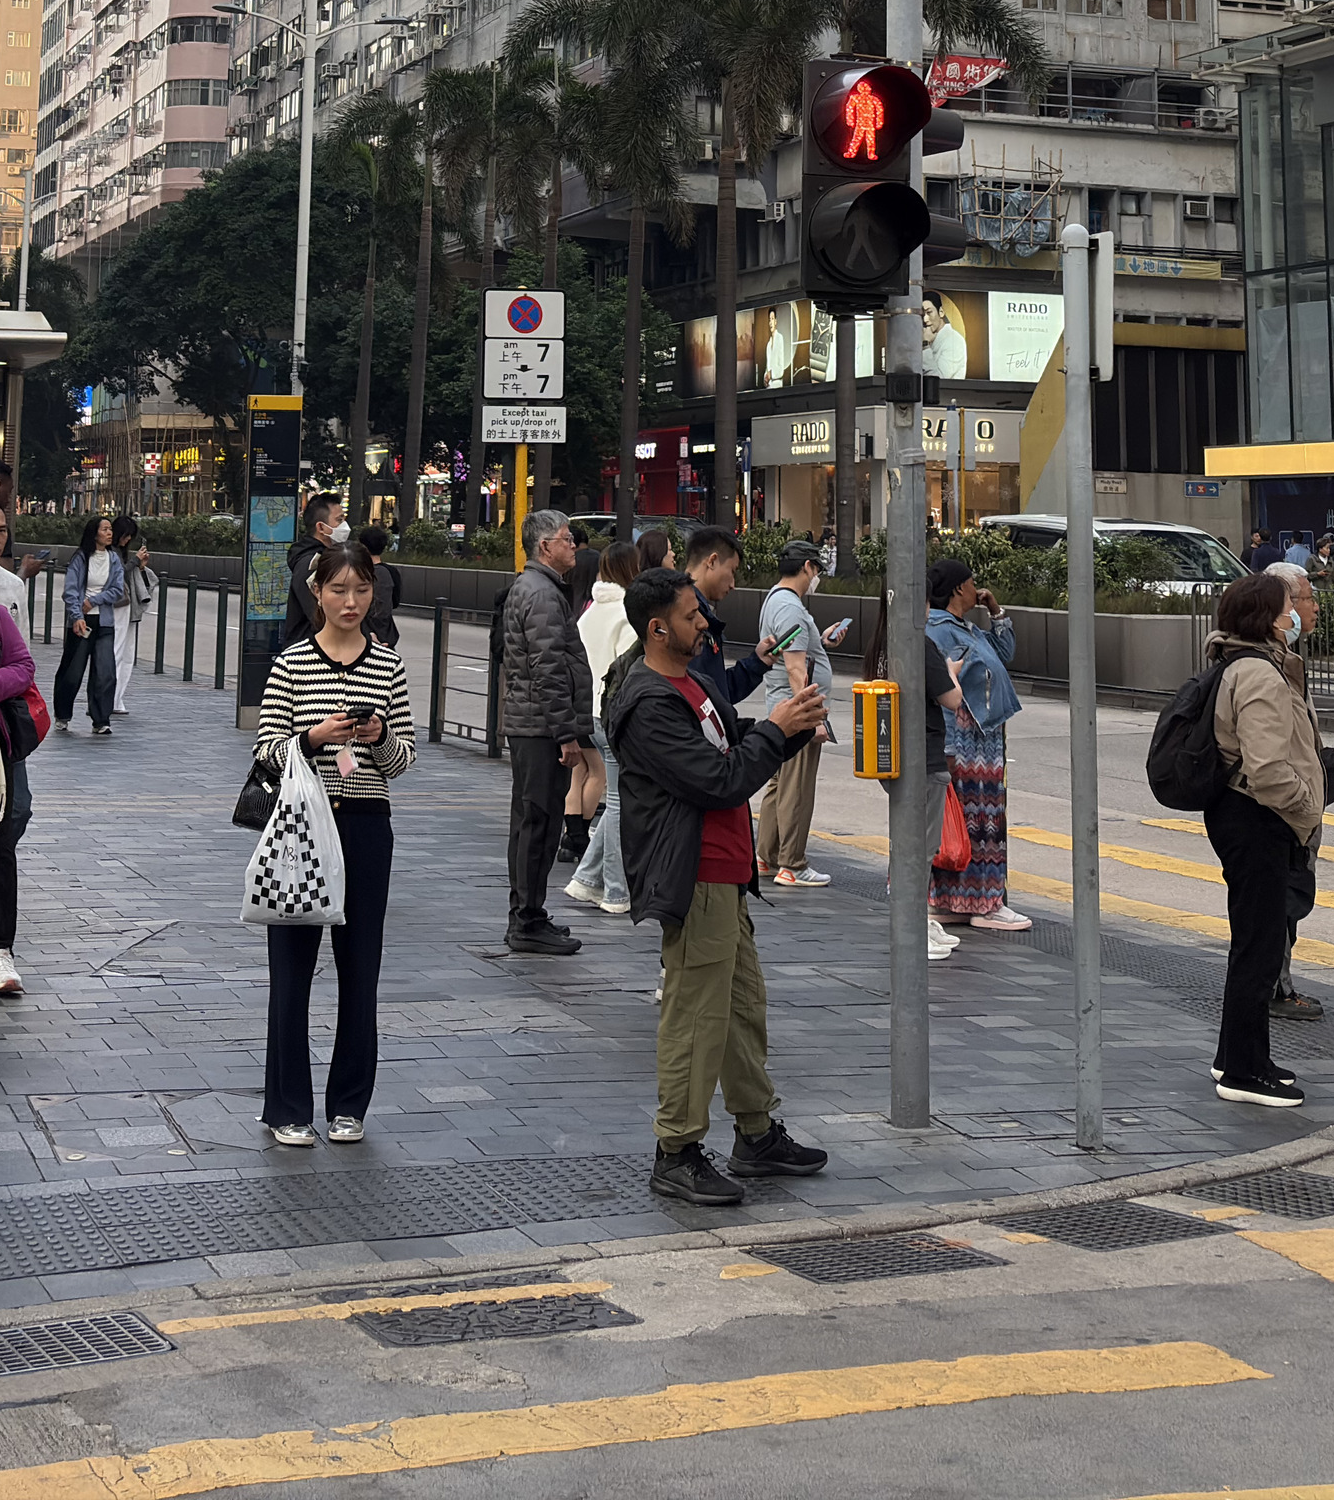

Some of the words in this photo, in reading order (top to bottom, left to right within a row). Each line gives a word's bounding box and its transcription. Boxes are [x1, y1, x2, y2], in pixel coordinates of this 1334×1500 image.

[1007, 302, 1048, 314] RADO
[499, 351, 522, 363] 上午
[537, 343, 550, 362] 7
[1006, 350, 1031, 373] Feel
[498, 383, 522, 394] 下午
[503, 373, 518, 381] pm
[536, 375, 550, 394] 7
[501, 408, 531, 418] Except
[531, 409, 547, 417] taxi
[491, 418, 508, 426] pick
[510, 418, 543, 427] up/drop
[544, 418, 557, 426] off
[922, 418, 995, 440] RAO
[486, 429, 561, 440] 的士上落客除外
[791, 421, 828, 442] RADO
[635, 442, 657, 459] SSOT
